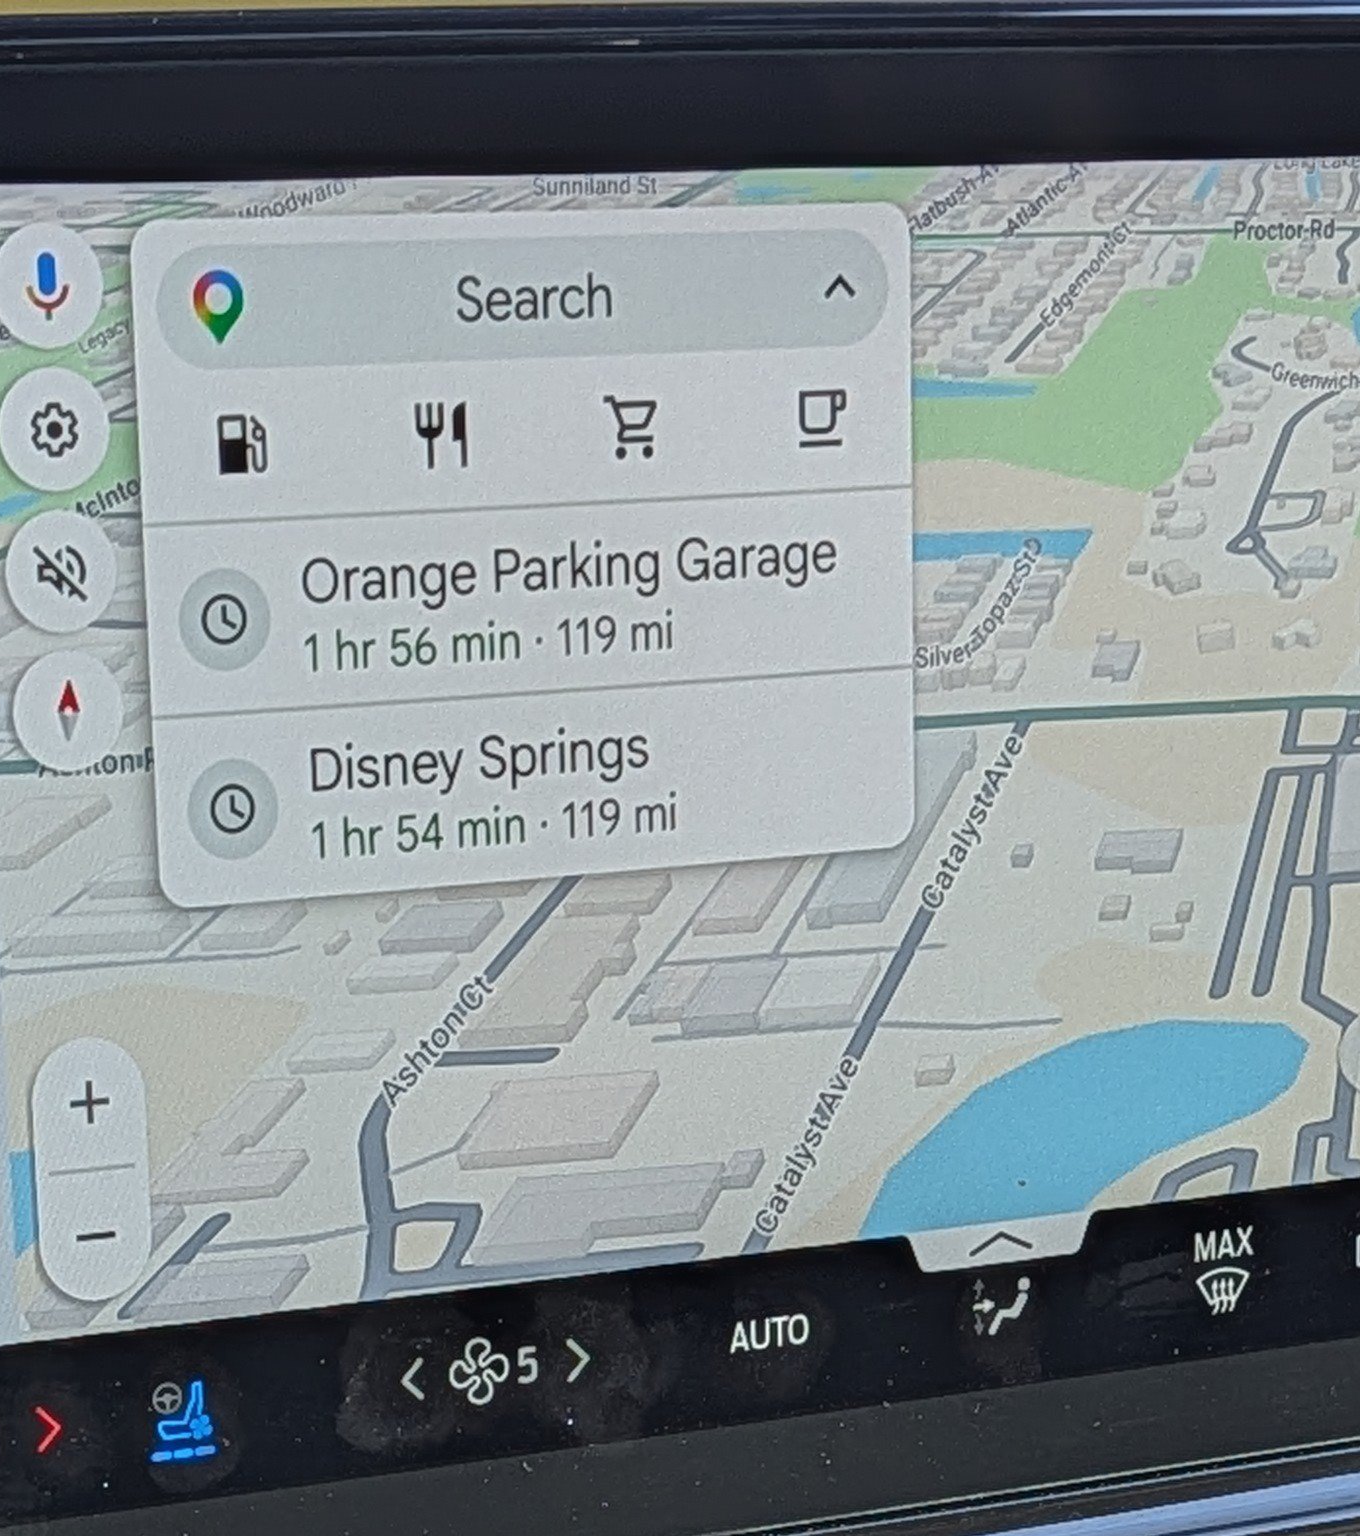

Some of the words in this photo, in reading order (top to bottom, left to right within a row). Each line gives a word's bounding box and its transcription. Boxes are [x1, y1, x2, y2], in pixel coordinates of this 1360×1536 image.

[533, 176, 631, 197] Sunniland
[638, 174, 658, 195] St
[1006, 178, 1068, 237] Atlantic
[1233, 219, 1304, 242] Proctor
[1310, 218, 1336, 240] Rd
[455, 271, 614, 326] Search
[1040, 241, 1116, 327] Edgemont
[1112, 221, 1133, 245] Ct
[77, 317, 131, 354] Legacy
[1271, 361, 1360, 390] Greenwich
[301, 556, 477, 611] Orange
[493, 540, 661, 597] Parking
[676, 535, 839, 588] Garage
[303, 632, 319, 673] 1
[335, 628, 377, 671] hr
[389, 626, 438, 668] 56
[451, 619, 521, 665] min
[557, 614, 617, 657] 119
[630, 607, 675, 653] mi
[914, 643, 972, 669] Silver
[969, 579, 1020, 644] Topaz
[1013, 551, 1037, 579] St
[309, 741, 465, 796] Disney
[478, 726, 651, 791] Springs
[310, 820, 327, 860] 1
[342, 815, 384, 858] hr
[396, 811, 445, 854] 54
[457, 804, 527, 849] min
[561, 797, 622, 840] 119
[633, 790, 678, 835] mi
[921, 792, 994, 910] Catalyst
[983, 735, 1024, 793] Ave
[382, 1011, 465, 1108] Ashton
[459, 975, 495, 1011] Ct
[755, 1115, 830, 1234] Catalyst
[818, 1057, 859, 1115] Ave
[1193, 1224, 1255, 1264] MAX
[730, 1313, 810, 1354] AUTO
[517, 1345, 539, 1385] 5
